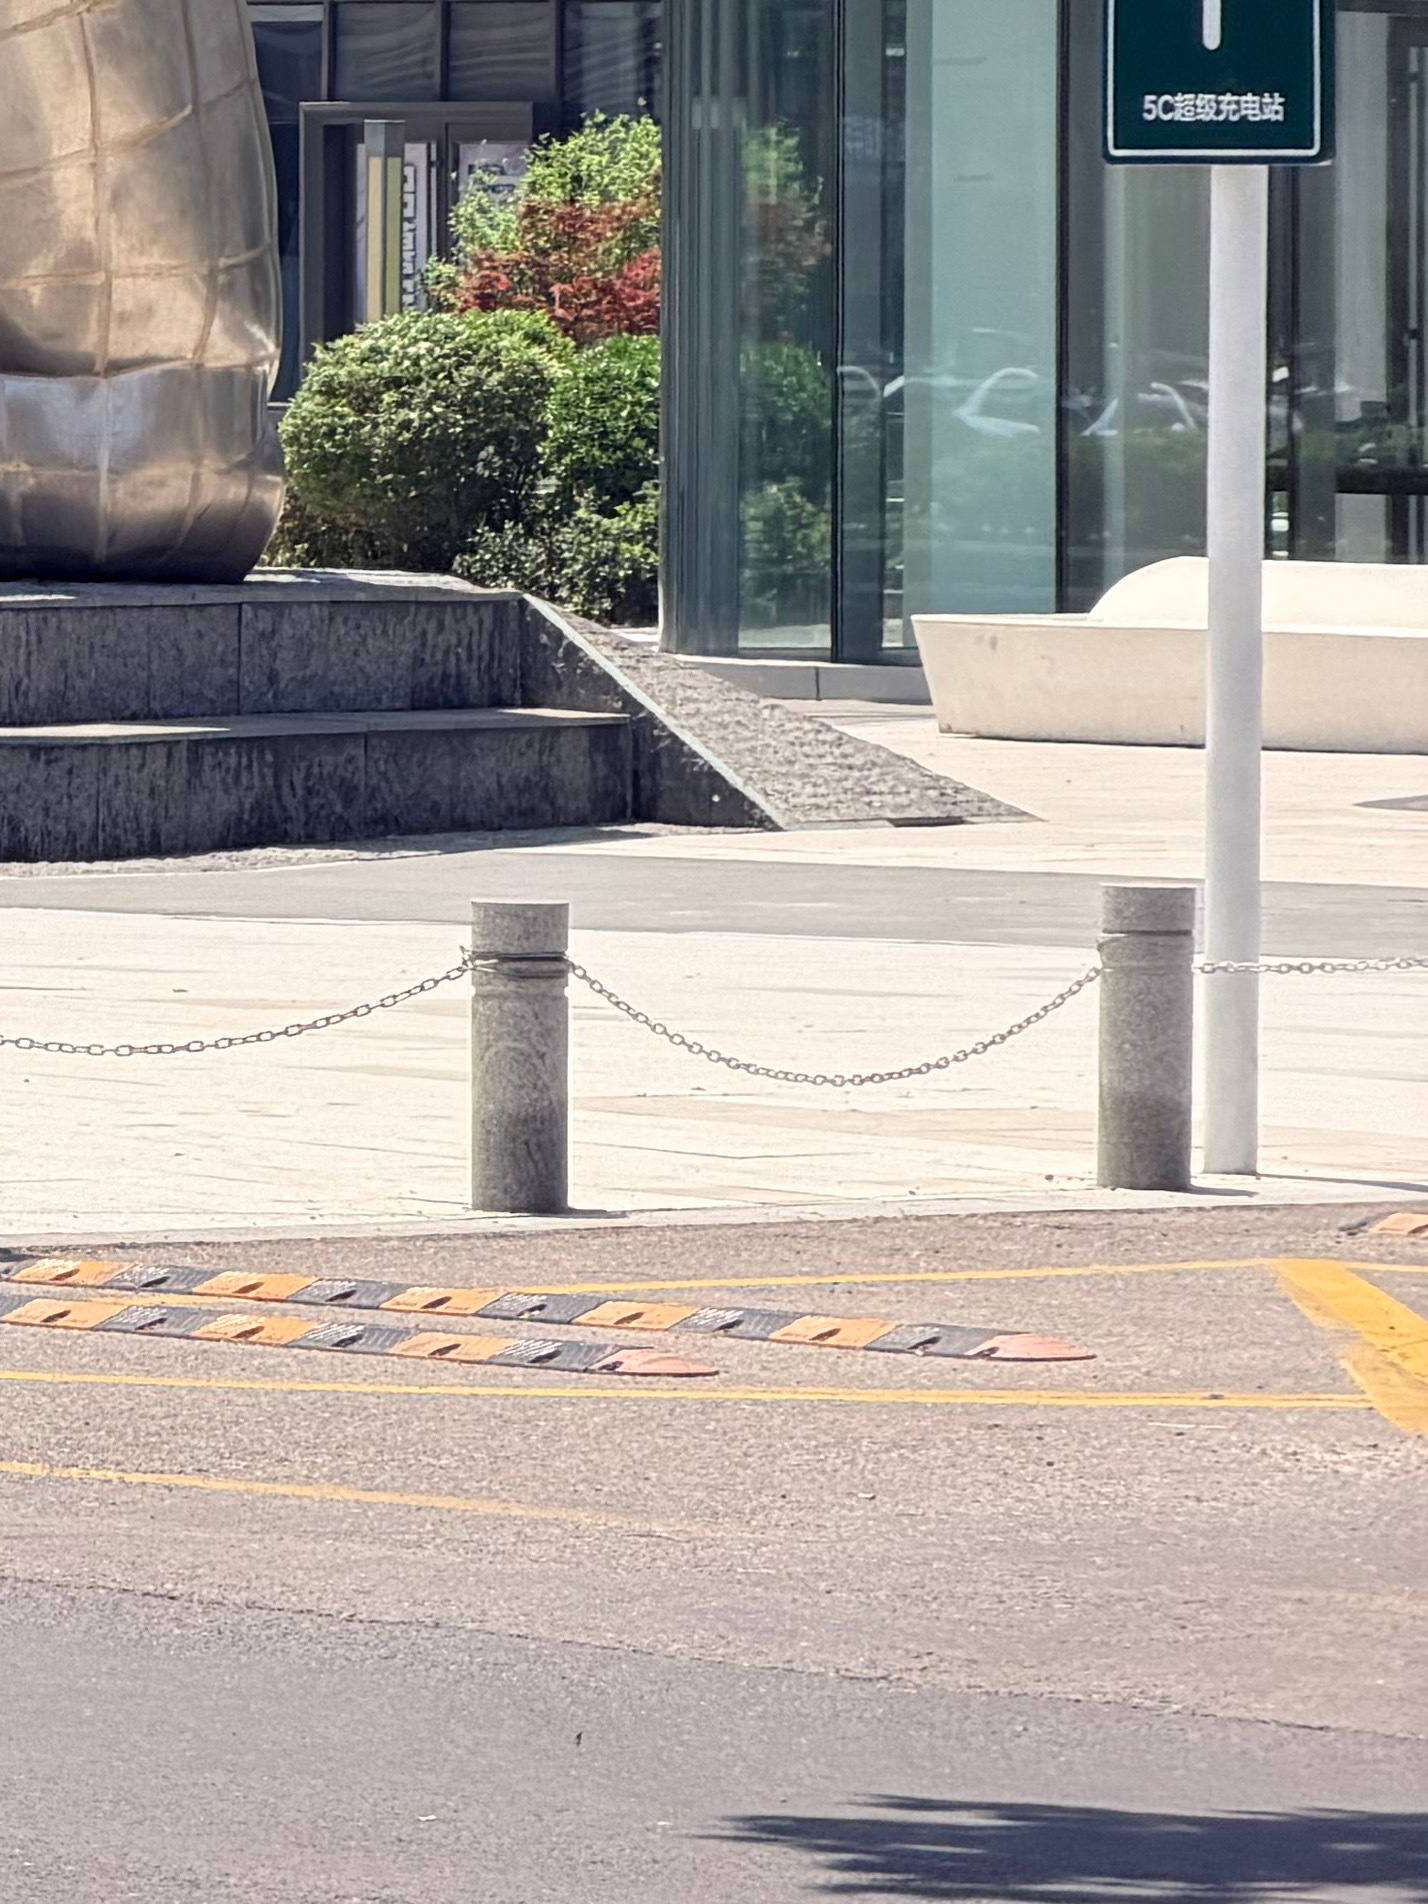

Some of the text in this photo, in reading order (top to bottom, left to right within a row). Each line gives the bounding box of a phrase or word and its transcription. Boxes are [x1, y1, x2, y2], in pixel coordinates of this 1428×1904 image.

[1142, 93, 1285, 122] 5C超级充电站
